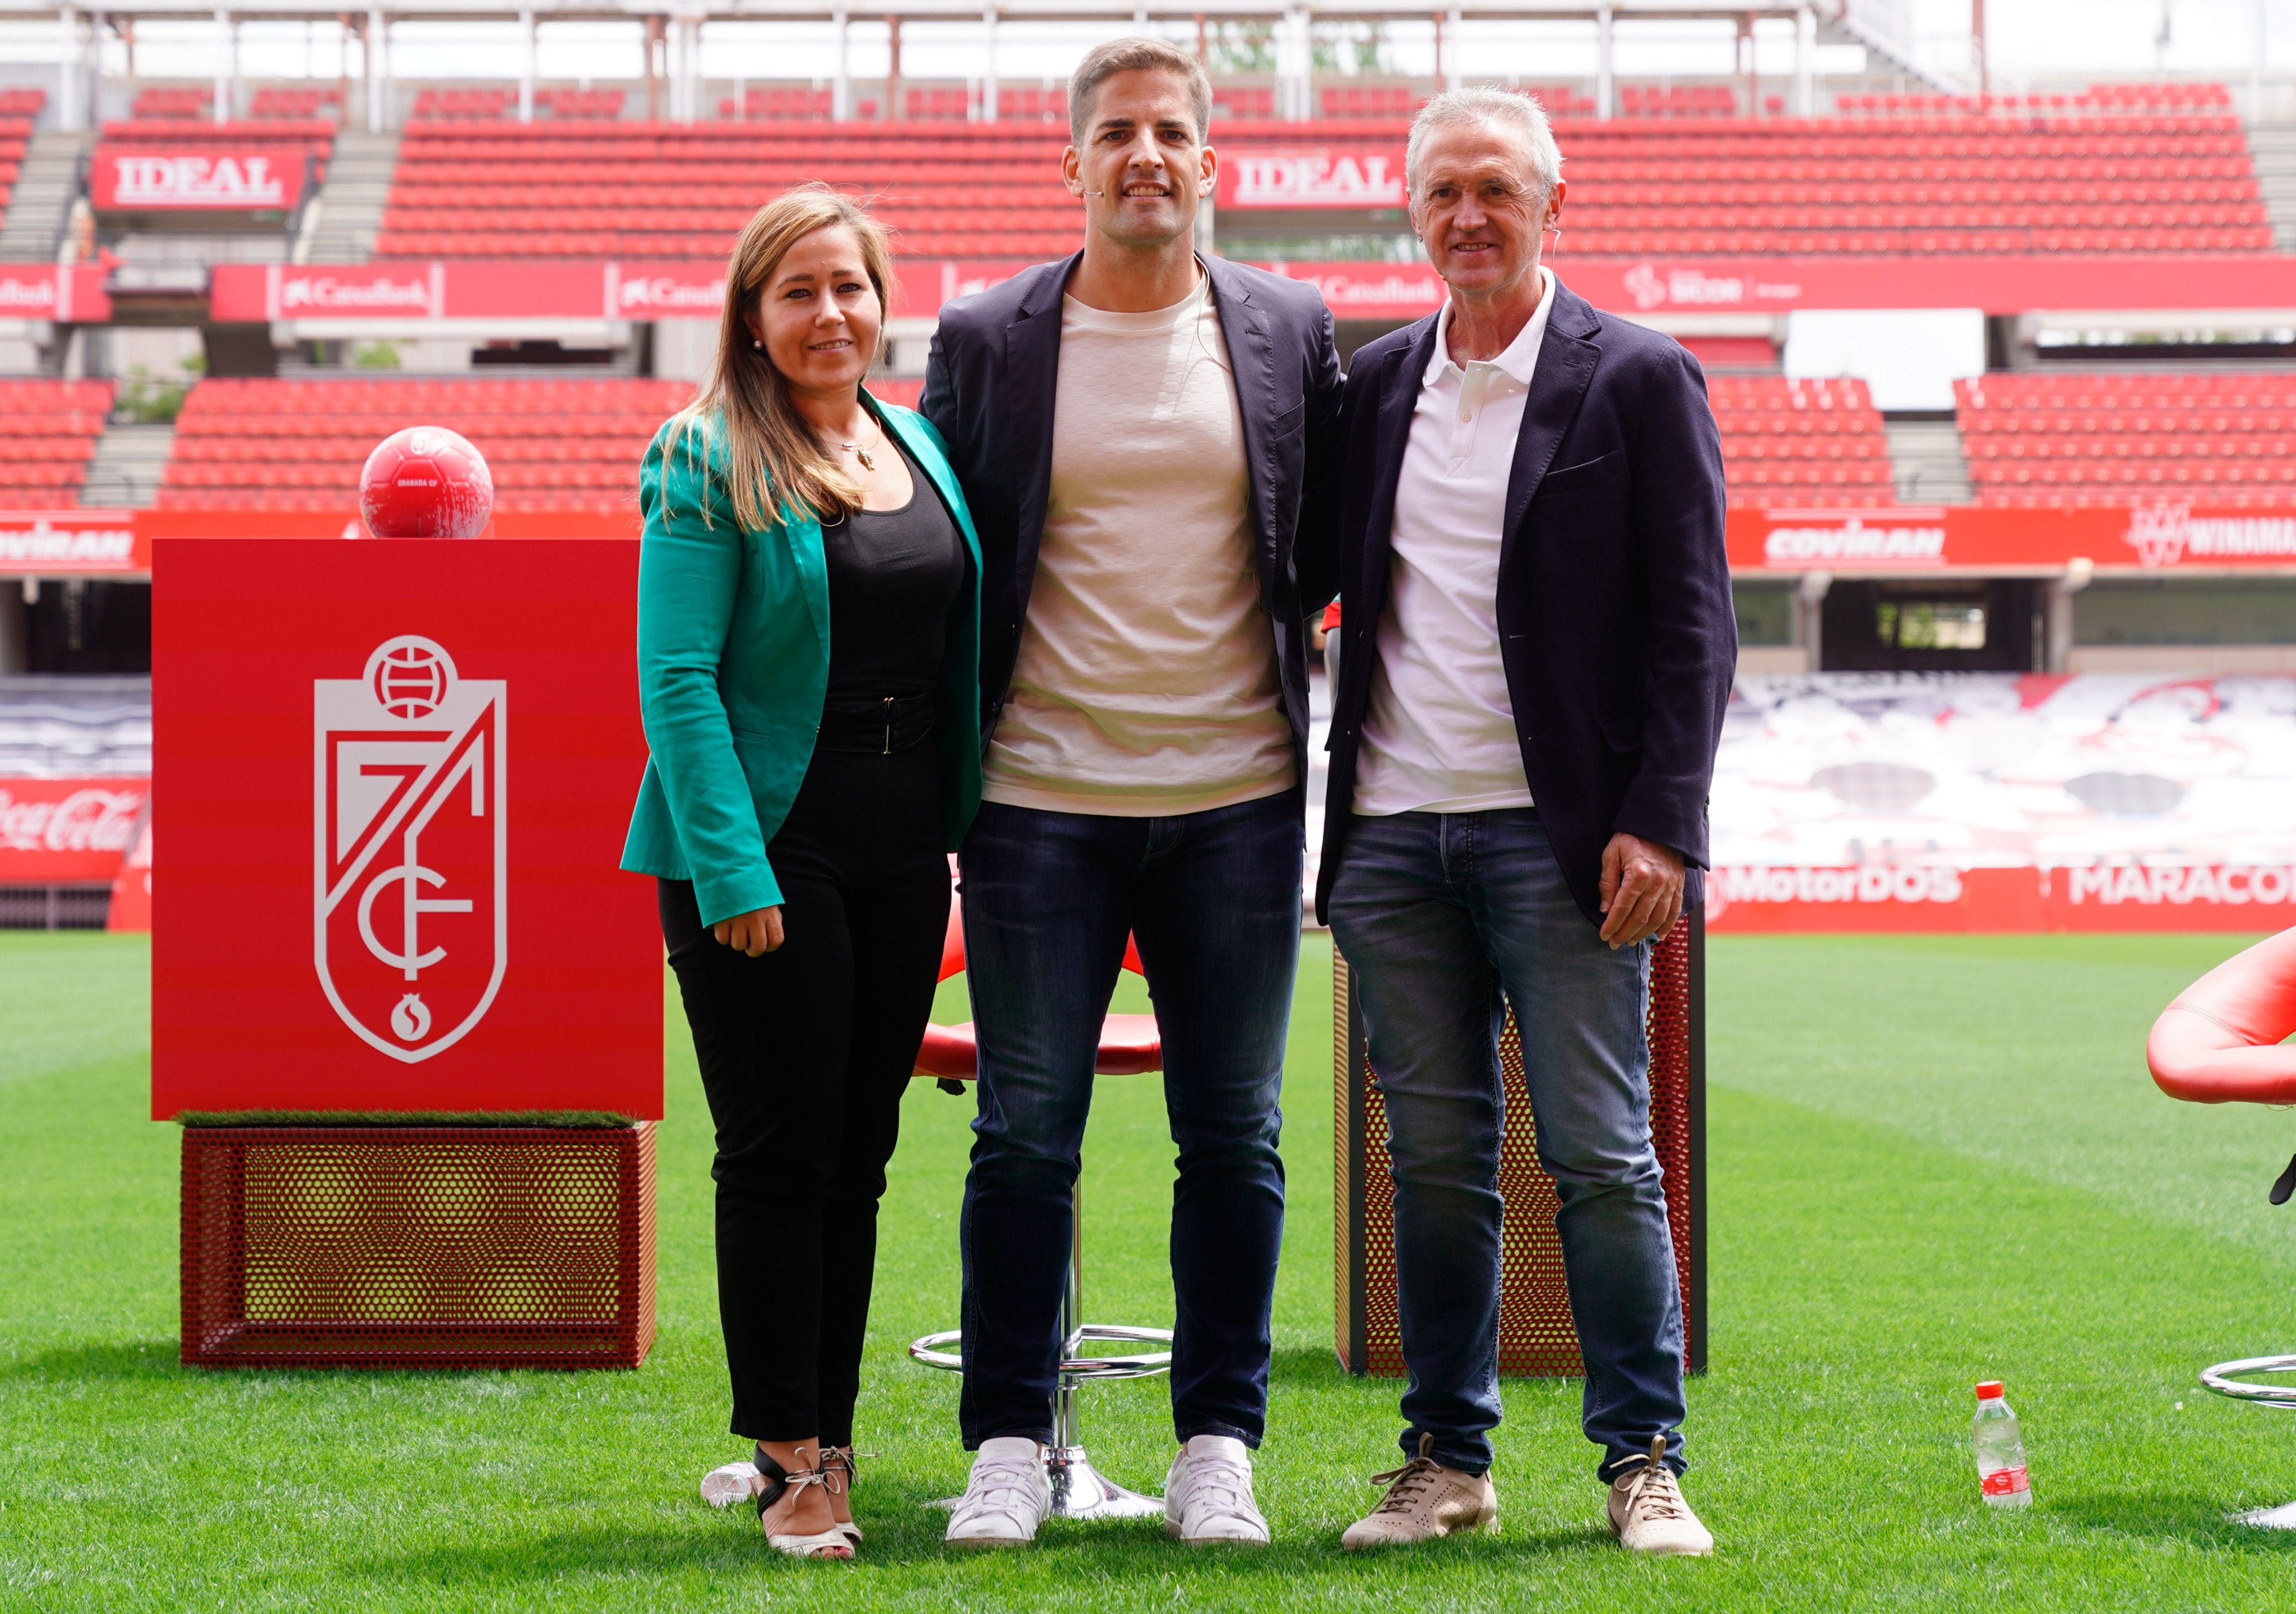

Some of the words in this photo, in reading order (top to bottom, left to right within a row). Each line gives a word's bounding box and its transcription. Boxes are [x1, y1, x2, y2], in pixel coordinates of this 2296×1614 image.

[113, 156, 283, 198] IDEAL
[1235, 156, 1402, 198] IDEAL
[397, 479, 427, 487] GRANADA
[429, 479, 438, 487] CF
[1727, 866, 1963, 903] MotorDOS
[2068, 866, 2296, 905] MARACO
